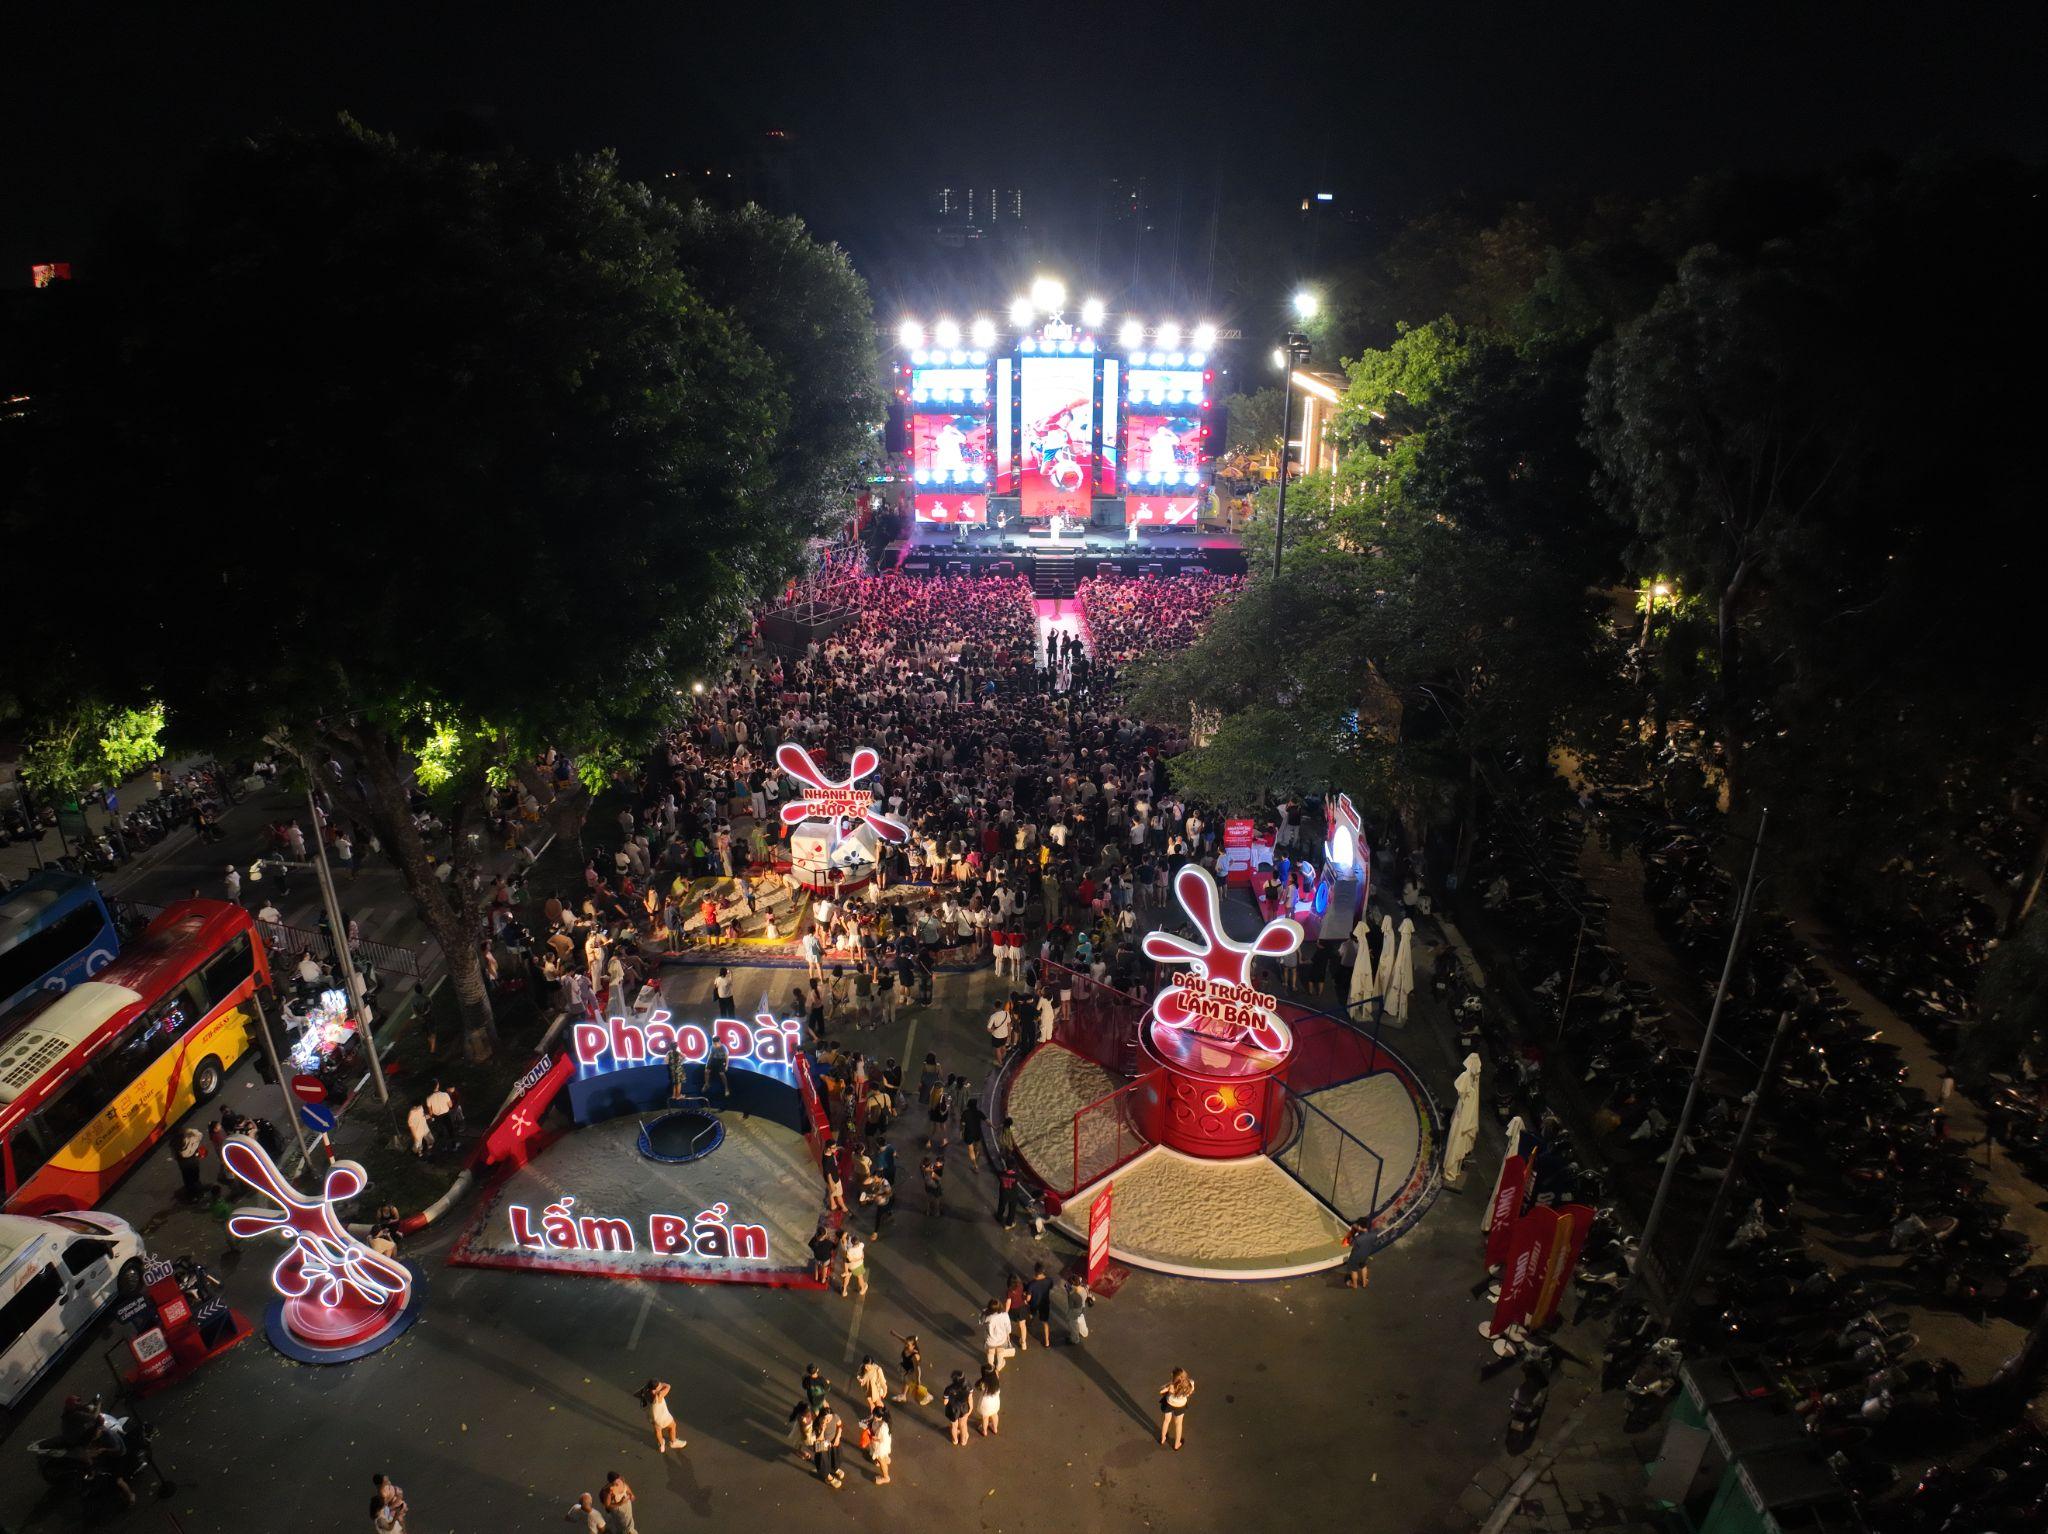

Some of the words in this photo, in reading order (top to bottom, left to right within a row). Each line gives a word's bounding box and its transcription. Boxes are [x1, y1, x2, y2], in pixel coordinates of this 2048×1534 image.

[804, 789, 847, 800] NHANH
[849, 790, 871, 801] TAY
[807, 801, 846, 816] CHỚP
[1173, 972, 1206, 993] ĐẤU
[1209, 982, 1275, 1010] TRƯỜNG
[1178, 993, 1219, 1018] LẤM
[1224, 1004, 1266, 1030] BẨN
[527, 1055, 552, 1086] OMO
[509, 1197, 635, 1253] Lấm
[650, 1202, 769, 1260] Bẩn
[143, 1261, 173, 1286] OMO
